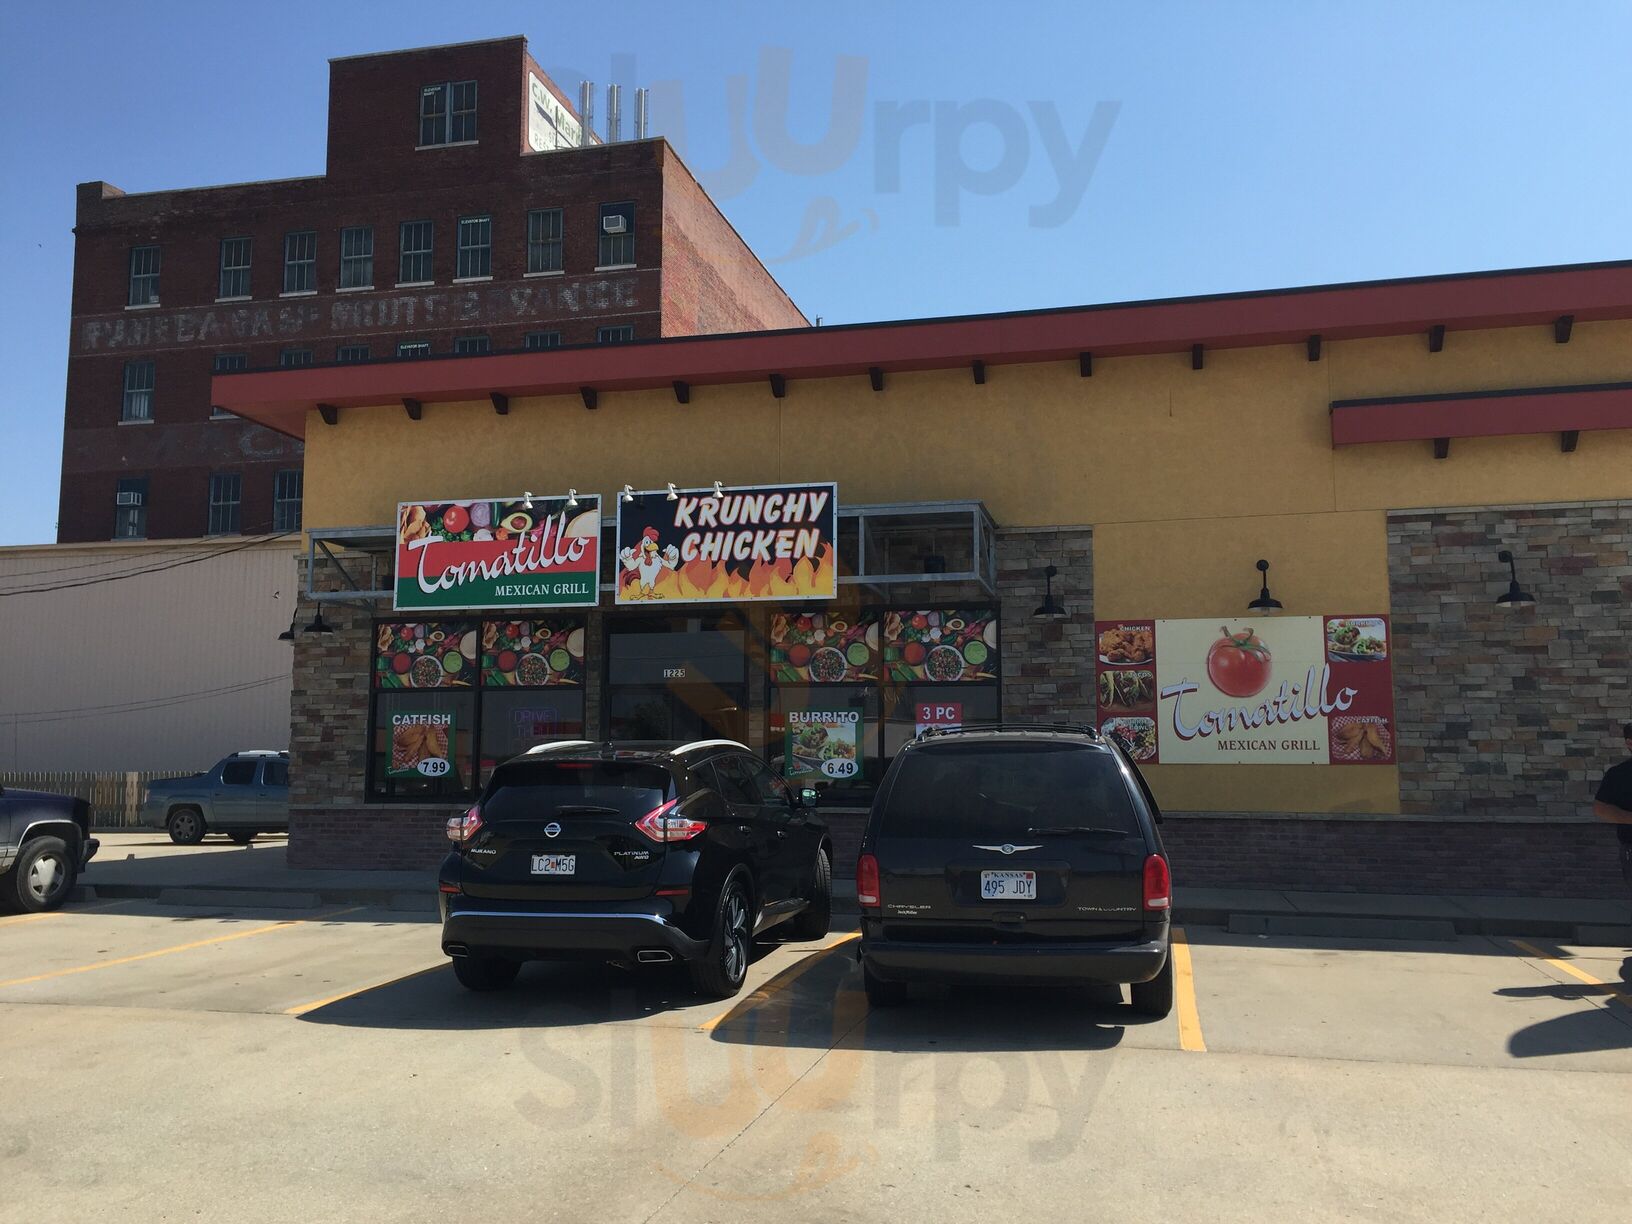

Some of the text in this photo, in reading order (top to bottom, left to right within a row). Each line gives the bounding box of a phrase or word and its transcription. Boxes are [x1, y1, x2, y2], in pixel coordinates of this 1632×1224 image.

[673, 490, 829, 529] KRUNCHY
[408, 510, 591, 594] Tomatillo
[680, 528, 820, 563] CHICKEN
[494, 582, 589, 597] MEXICAN GRILL
[664, 669, 685, 677] 1225
[1161, 663, 1359, 741] Tomatillo
[392, 714, 451, 726] CATFISH
[789, 711, 859, 723] BURRITO
[922, 706, 955, 720] 3 PC
[1217, 739, 1321, 751] MEXICAN GRILL
[984, 880, 1033, 895] 495 JDY
